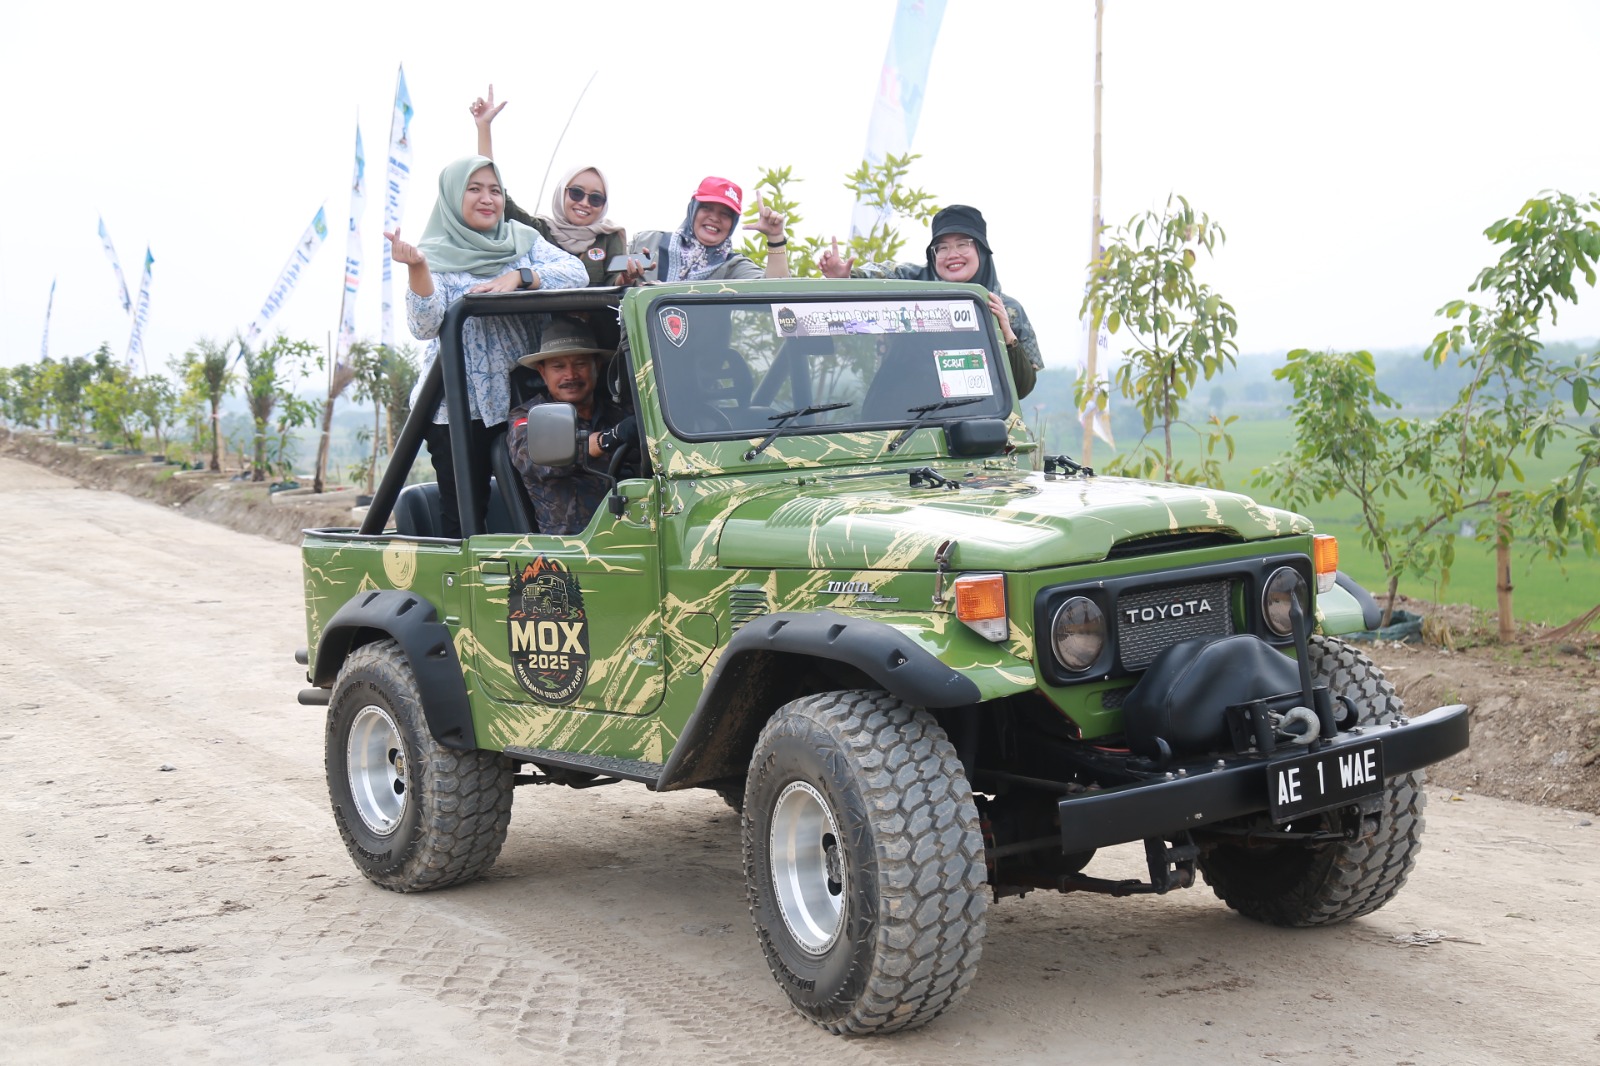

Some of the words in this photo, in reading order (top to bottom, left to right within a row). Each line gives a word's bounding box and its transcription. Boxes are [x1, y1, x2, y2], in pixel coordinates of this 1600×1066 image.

[811, 310, 852, 323] PESONA
[854, 309, 880, 323] BUMI
[954, 310, 971, 322] 001
[827, 581, 869, 592] TOYOTA
[1126, 599, 1212, 623] TOYOTA
[510, 620, 586, 655] MOX
[528, 653, 570, 670] 2025
[517, 663, 545, 697] MATARAMAN
[1278, 767, 1302, 805] AE
[1317, 761, 1325, 795] 1
[1338, 748, 1377, 789] WAE
